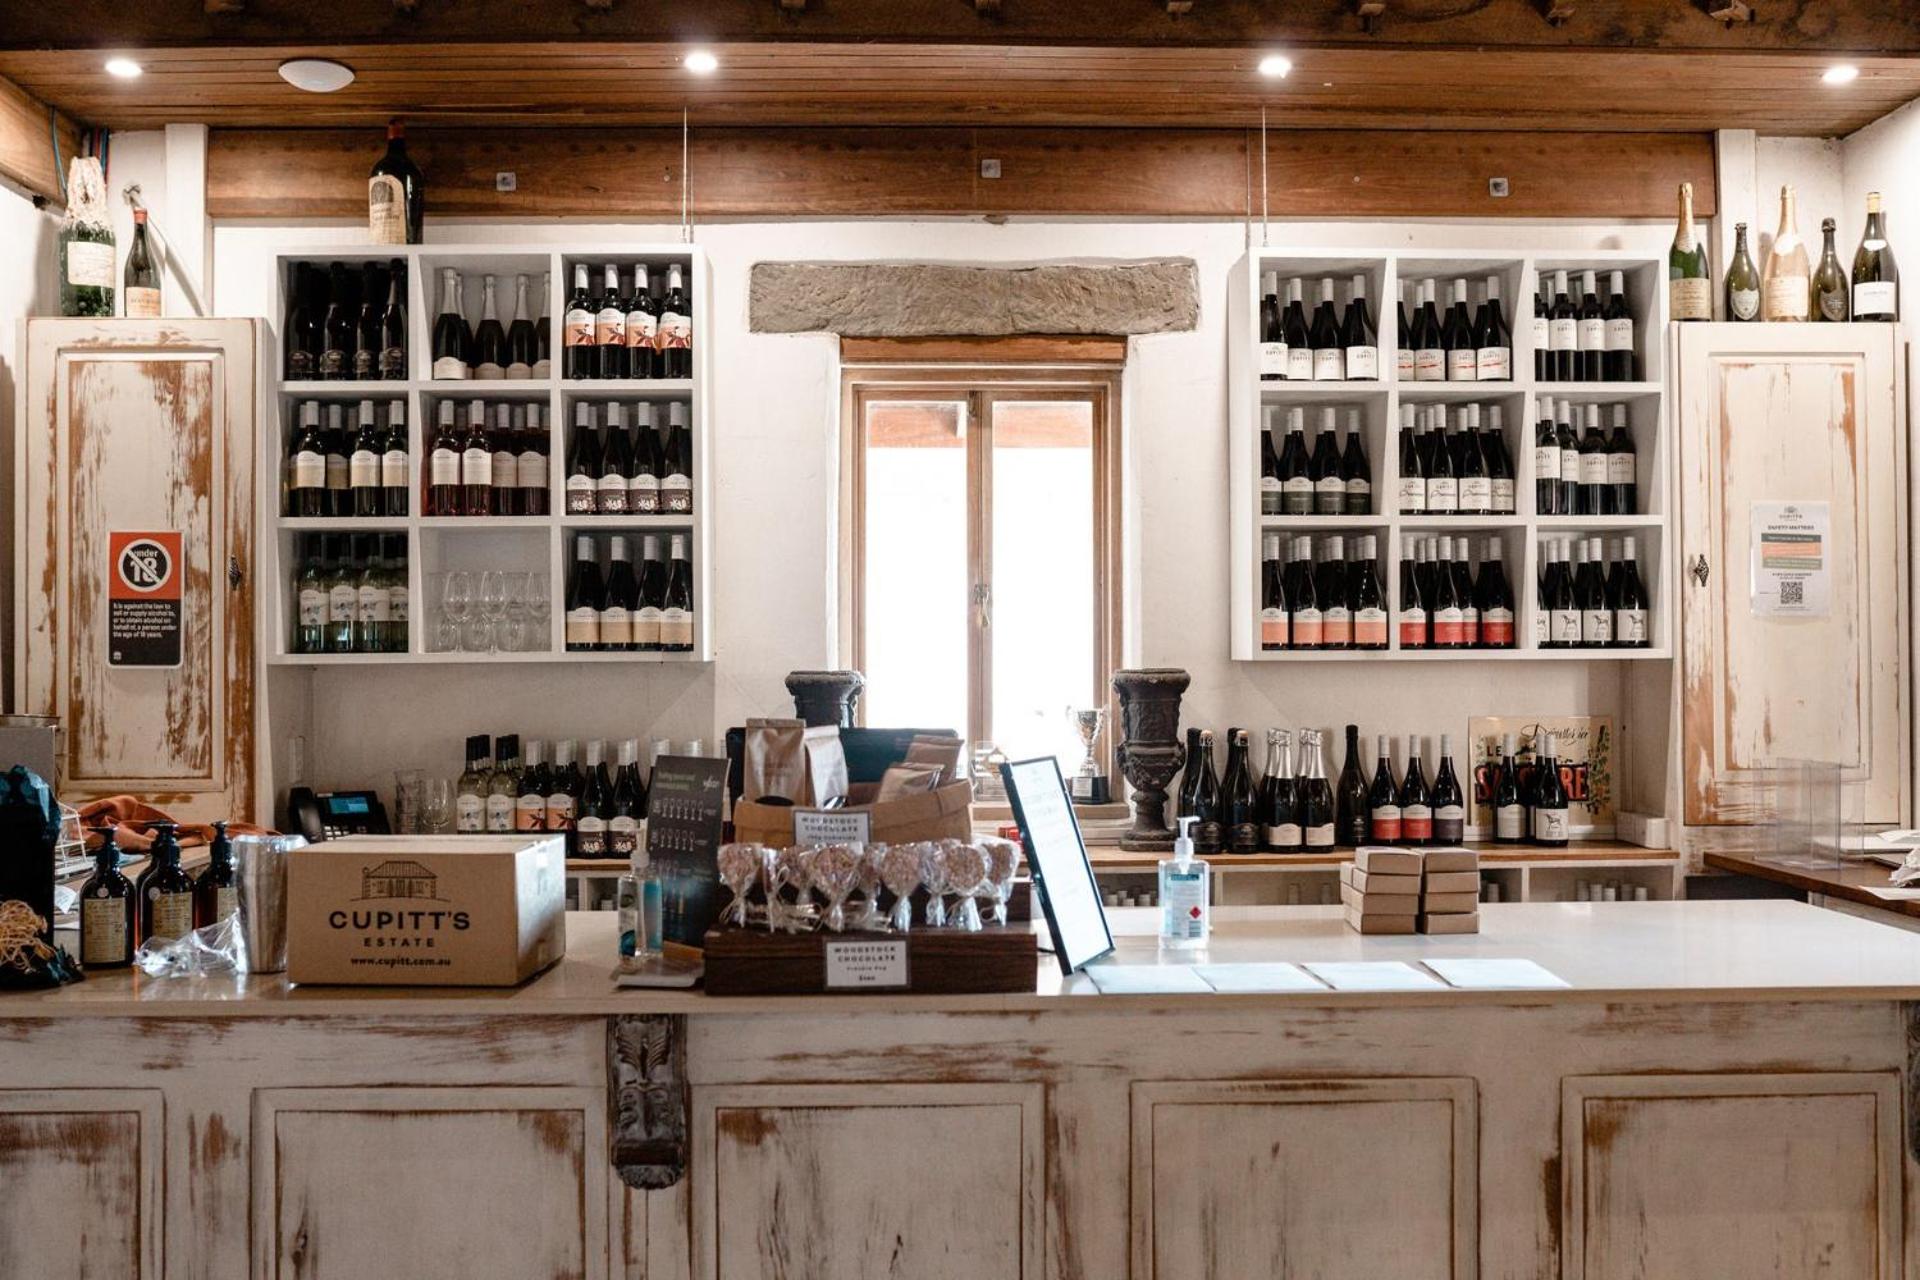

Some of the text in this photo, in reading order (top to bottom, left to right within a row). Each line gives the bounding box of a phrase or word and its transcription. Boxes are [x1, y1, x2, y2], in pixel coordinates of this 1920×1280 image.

[130, 557, 157, 582] 18
[1486, 746, 1503, 757] LE
[328, 911, 471, 930] CUPITT'S
[363, 937, 436, 948] ESTATE
[834, 945, 896, 953] WOODSTOCK
[350, 956, 451, 969] www.cupitt.com.au
[837, 954, 895, 963] CHOCOLATE
